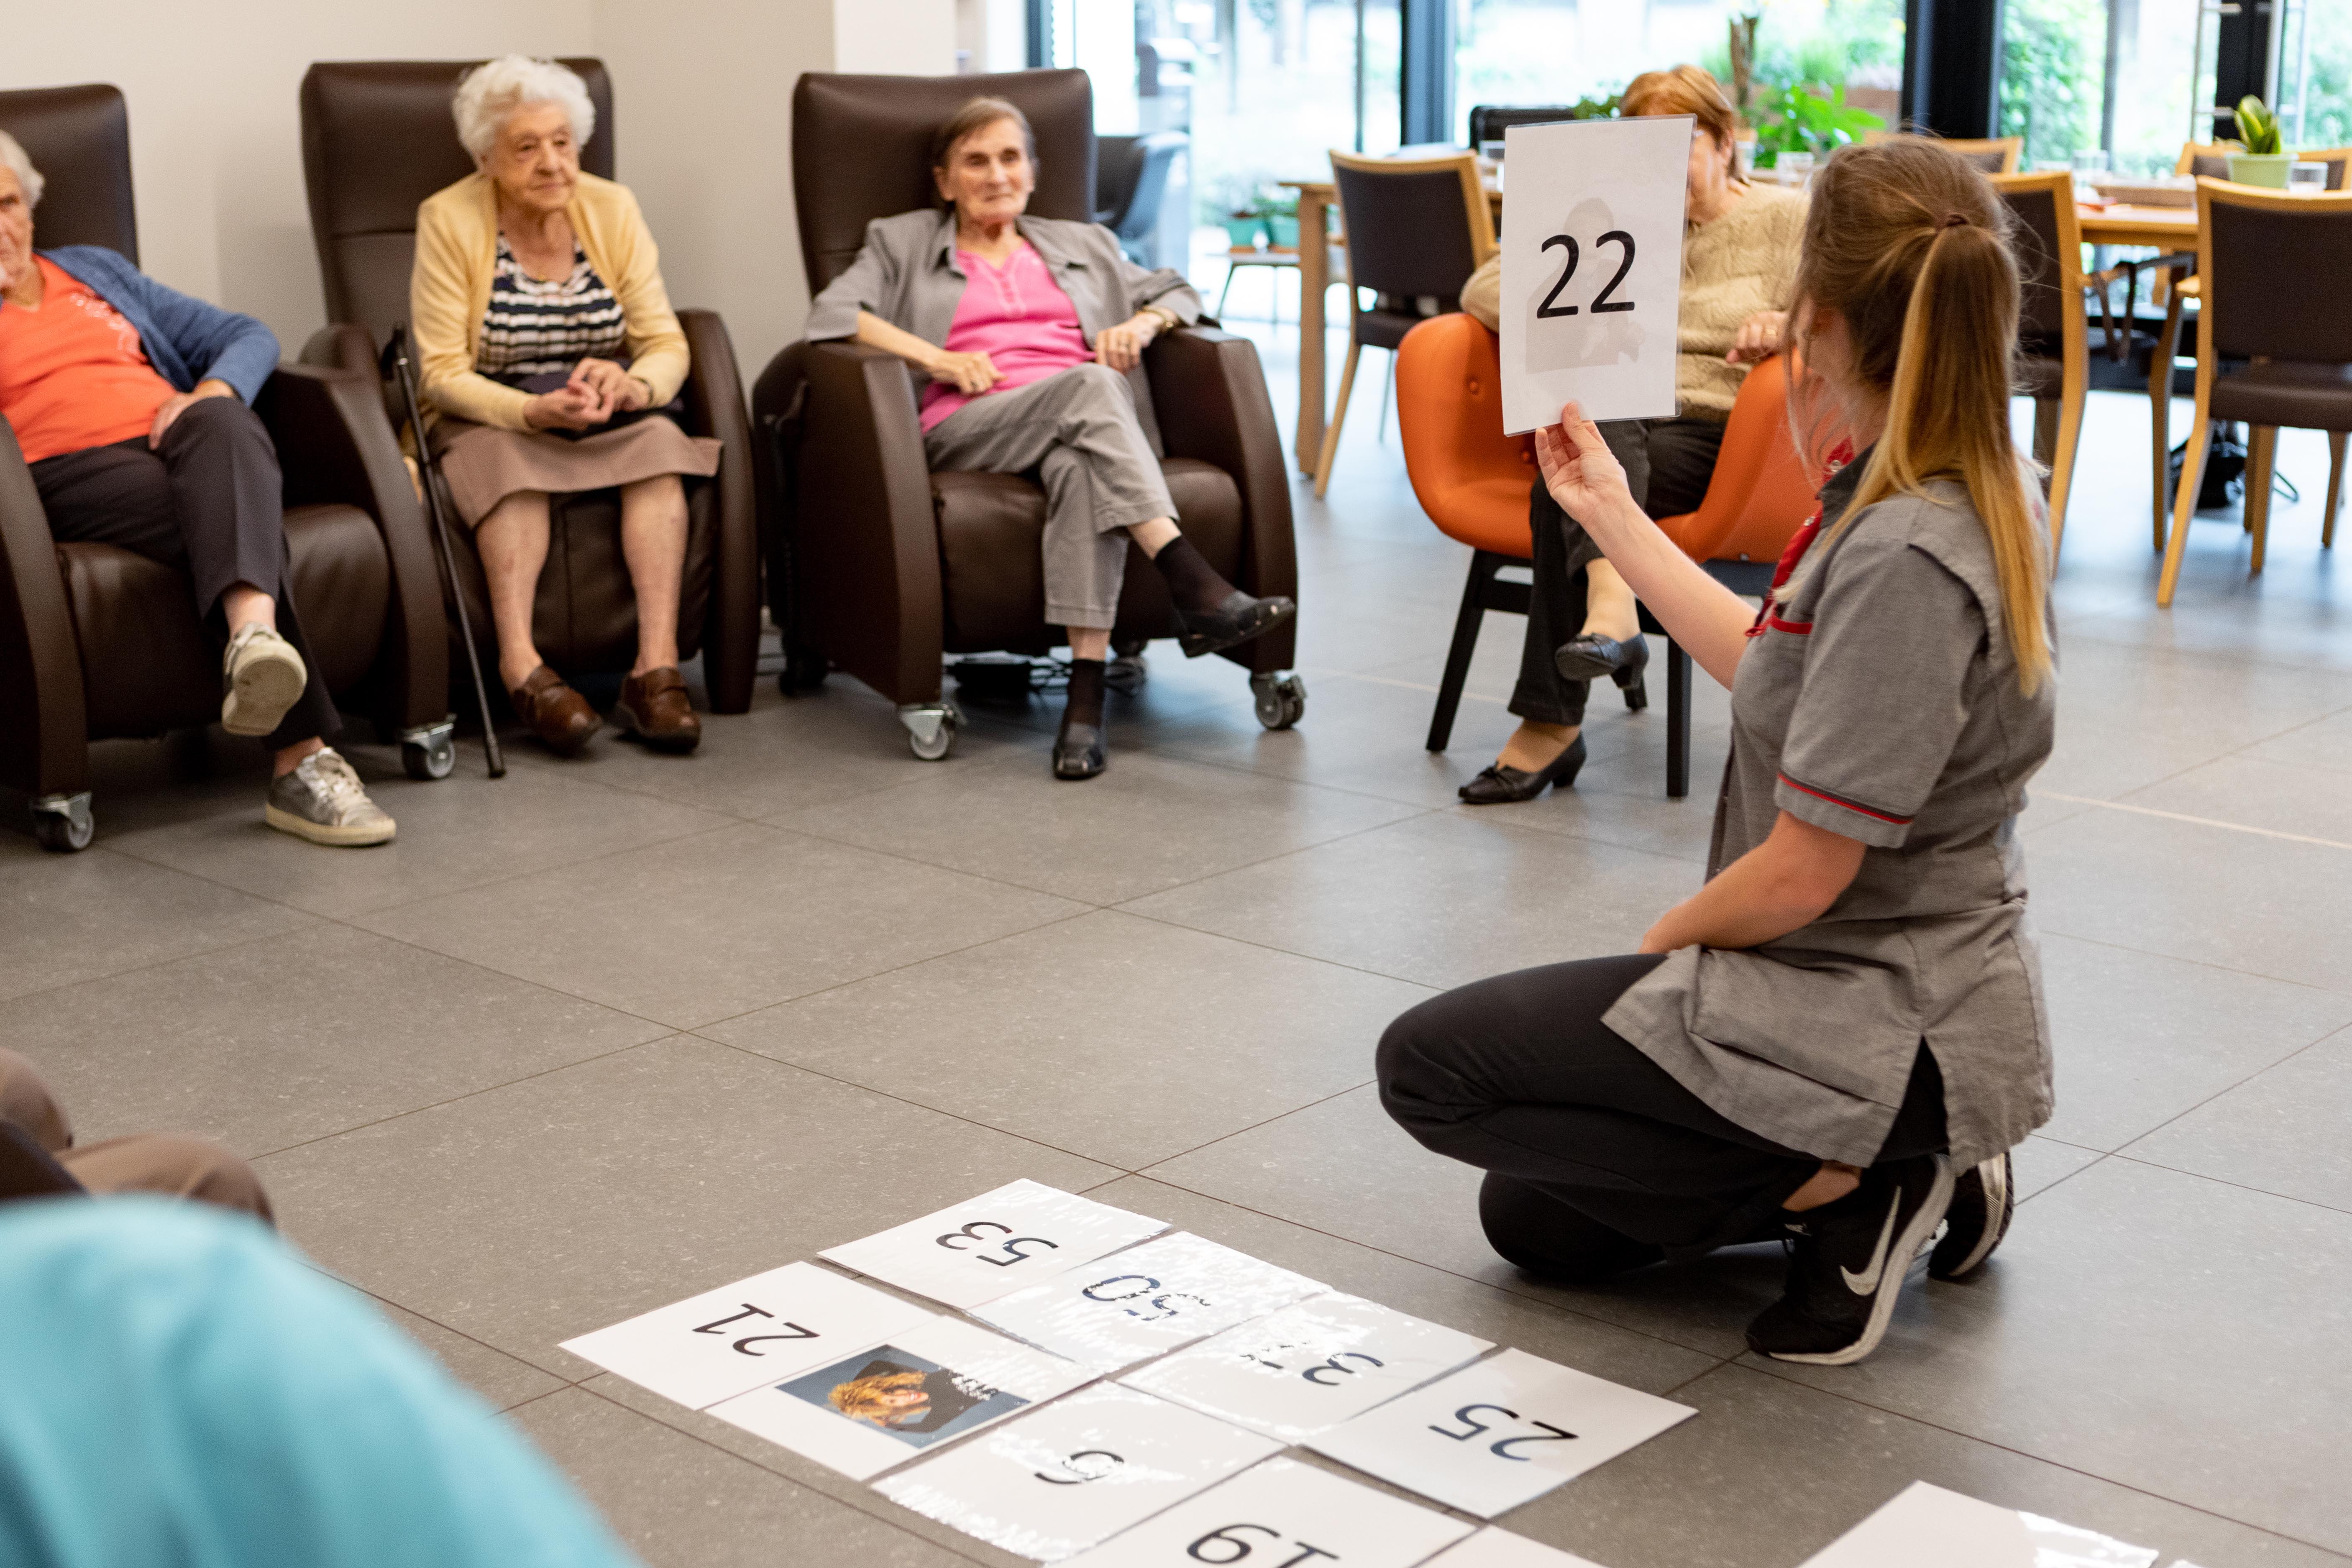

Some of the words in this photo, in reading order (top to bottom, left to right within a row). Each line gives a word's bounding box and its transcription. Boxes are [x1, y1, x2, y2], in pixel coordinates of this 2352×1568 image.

[1536, 230, 1635, 319] 22
[937, 1222, 1058, 1266] 53
[1083, 1276, 1210, 1320] 50
[693, 1304, 819, 1356] 21
[1429, 1404, 1579, 1461] 25
